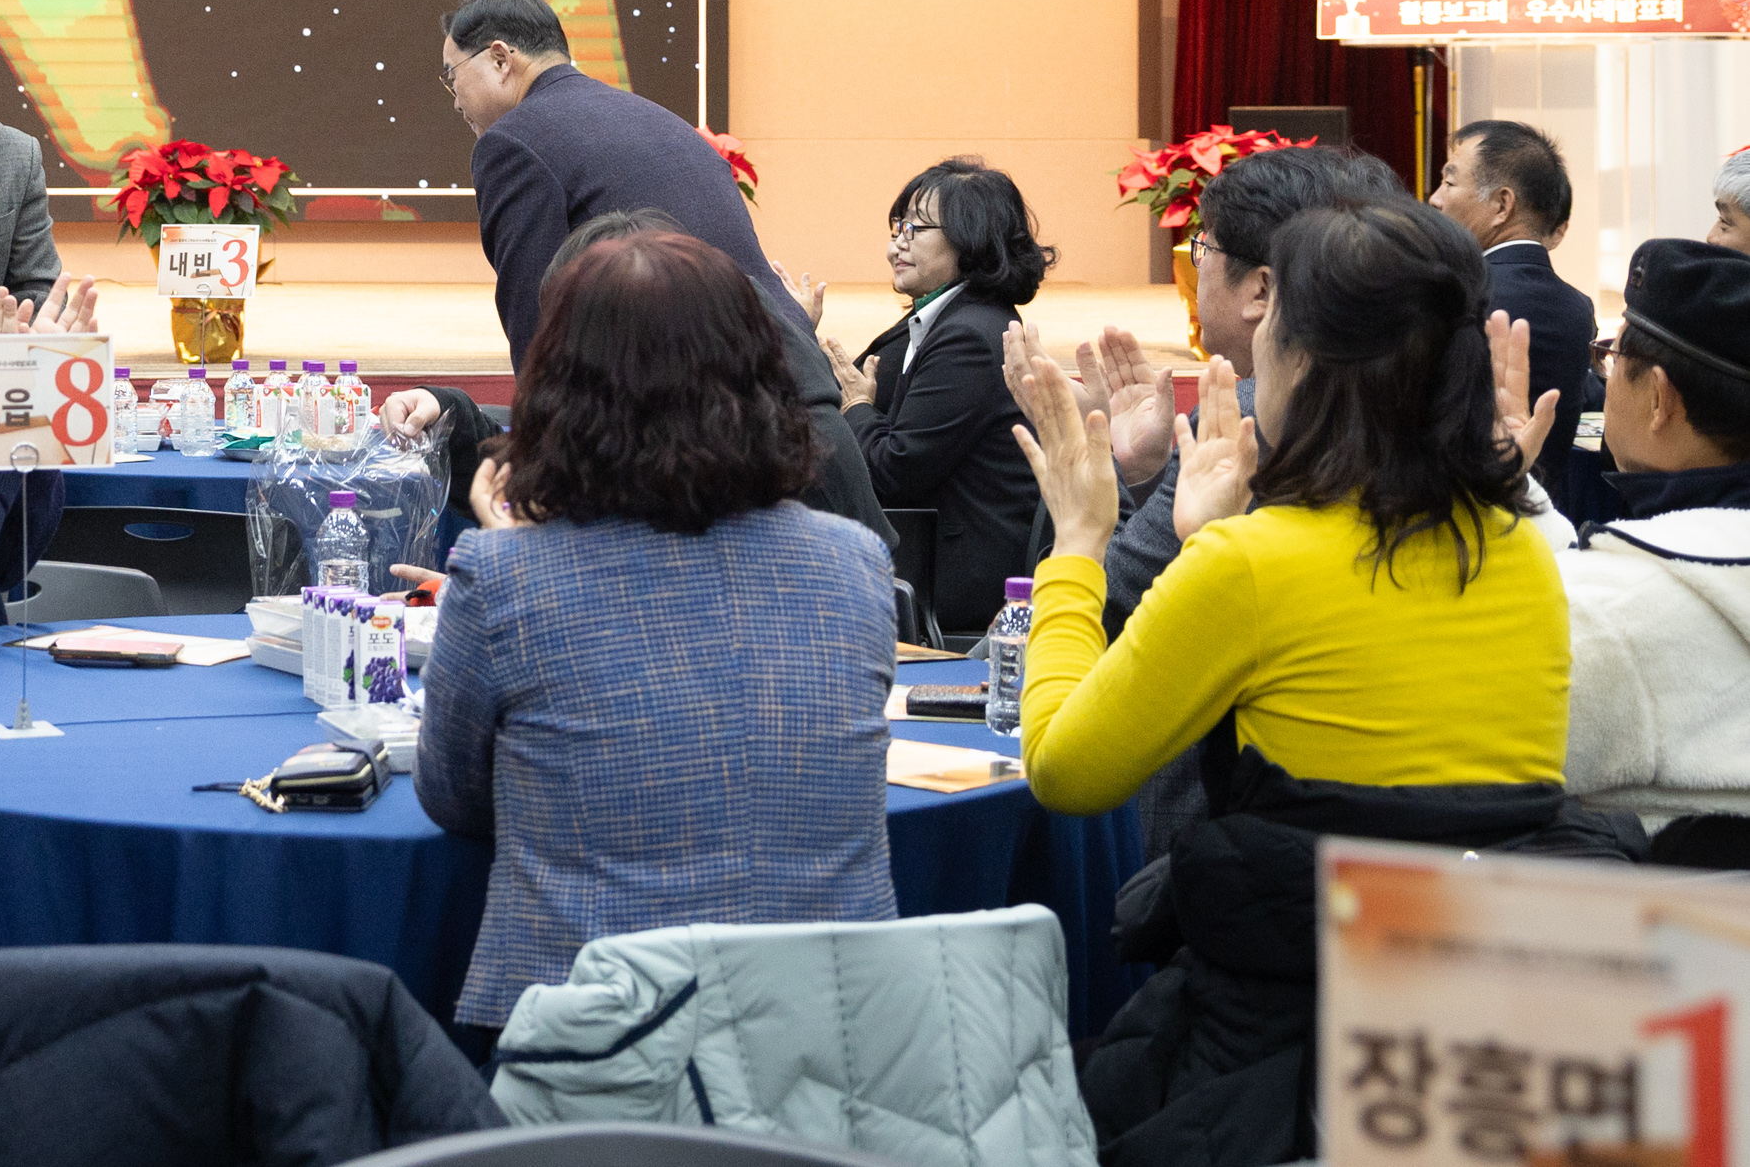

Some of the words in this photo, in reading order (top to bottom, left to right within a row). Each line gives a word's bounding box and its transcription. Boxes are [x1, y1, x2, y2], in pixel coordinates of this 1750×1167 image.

[219, 239, 250, 288] 3
[50, 357, 109, 447] 8
[368, 633, 394, 644] 포도
[1347, 1027, 1640, 1167] 장흥면
